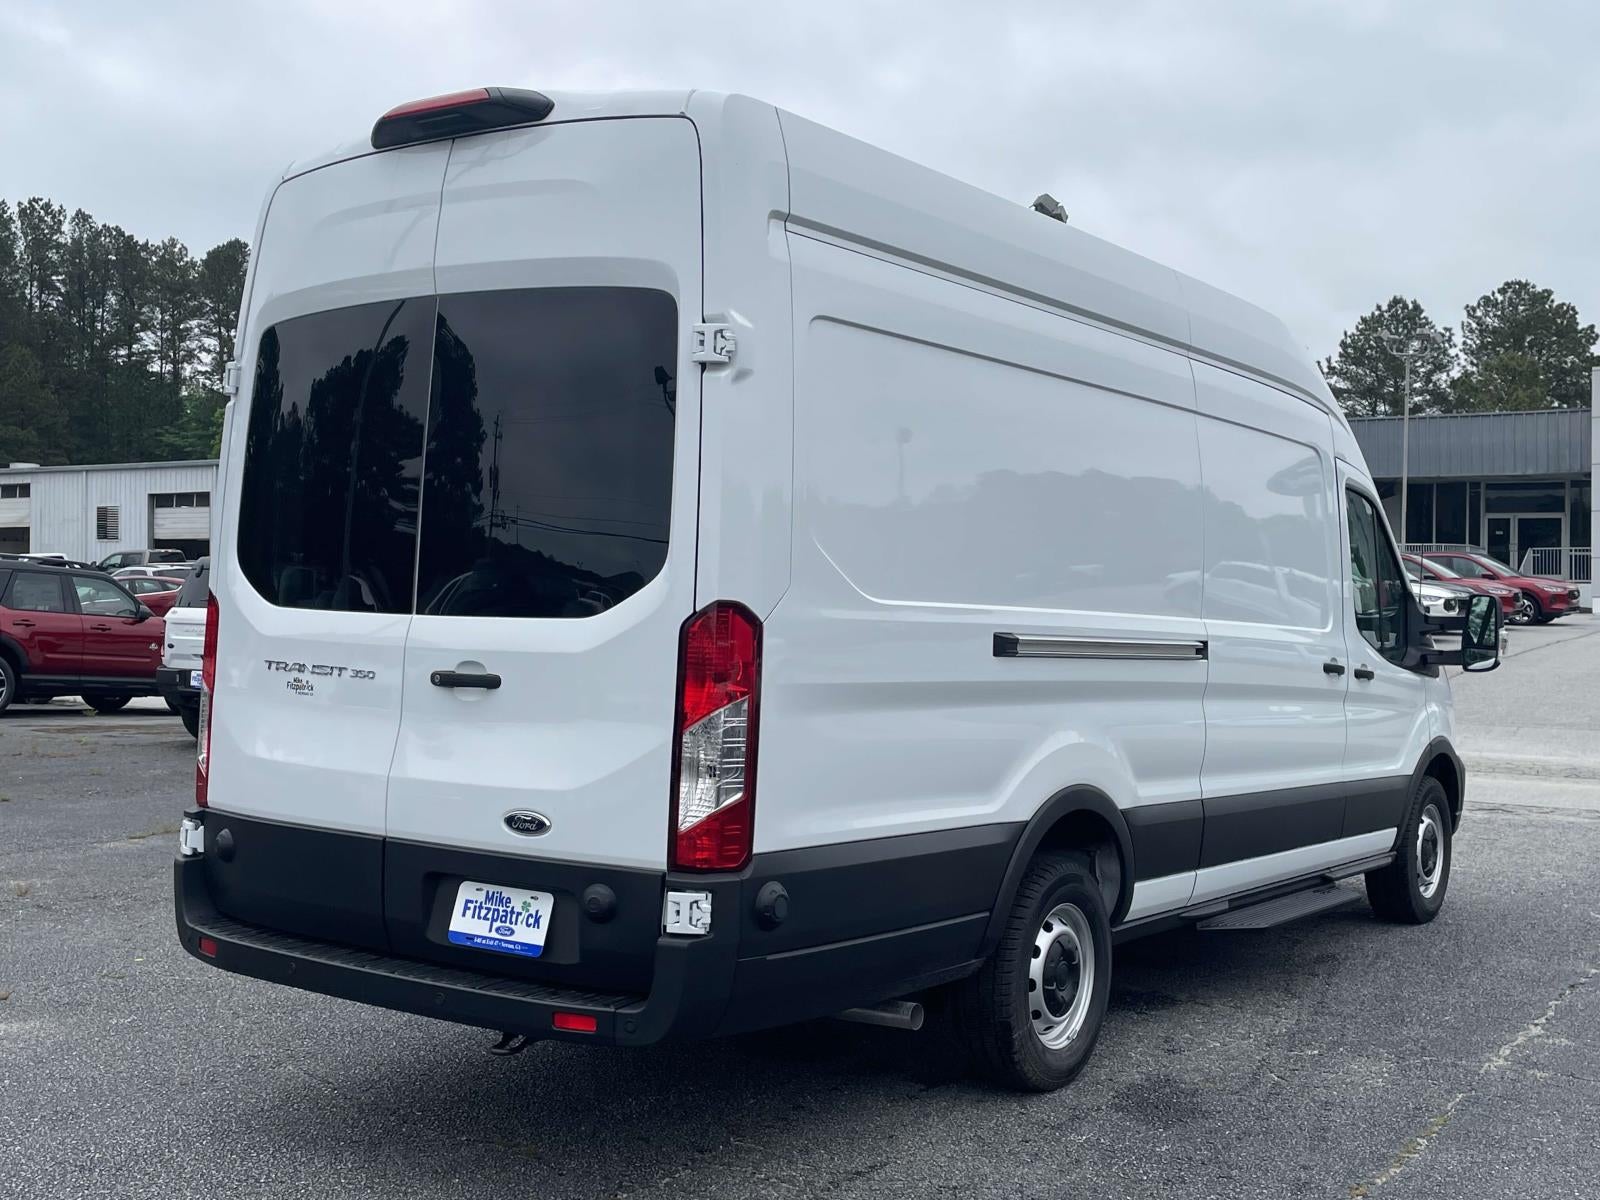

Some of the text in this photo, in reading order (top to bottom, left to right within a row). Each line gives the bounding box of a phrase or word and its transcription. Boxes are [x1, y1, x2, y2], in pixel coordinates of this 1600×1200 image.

[264, 660, 376, 680] TRANSIT 350
[511, 815, 538, 830] Ford
[484, 890, 511, 909] Mike
[461, 899, 542, 933] Fitzpatrick
